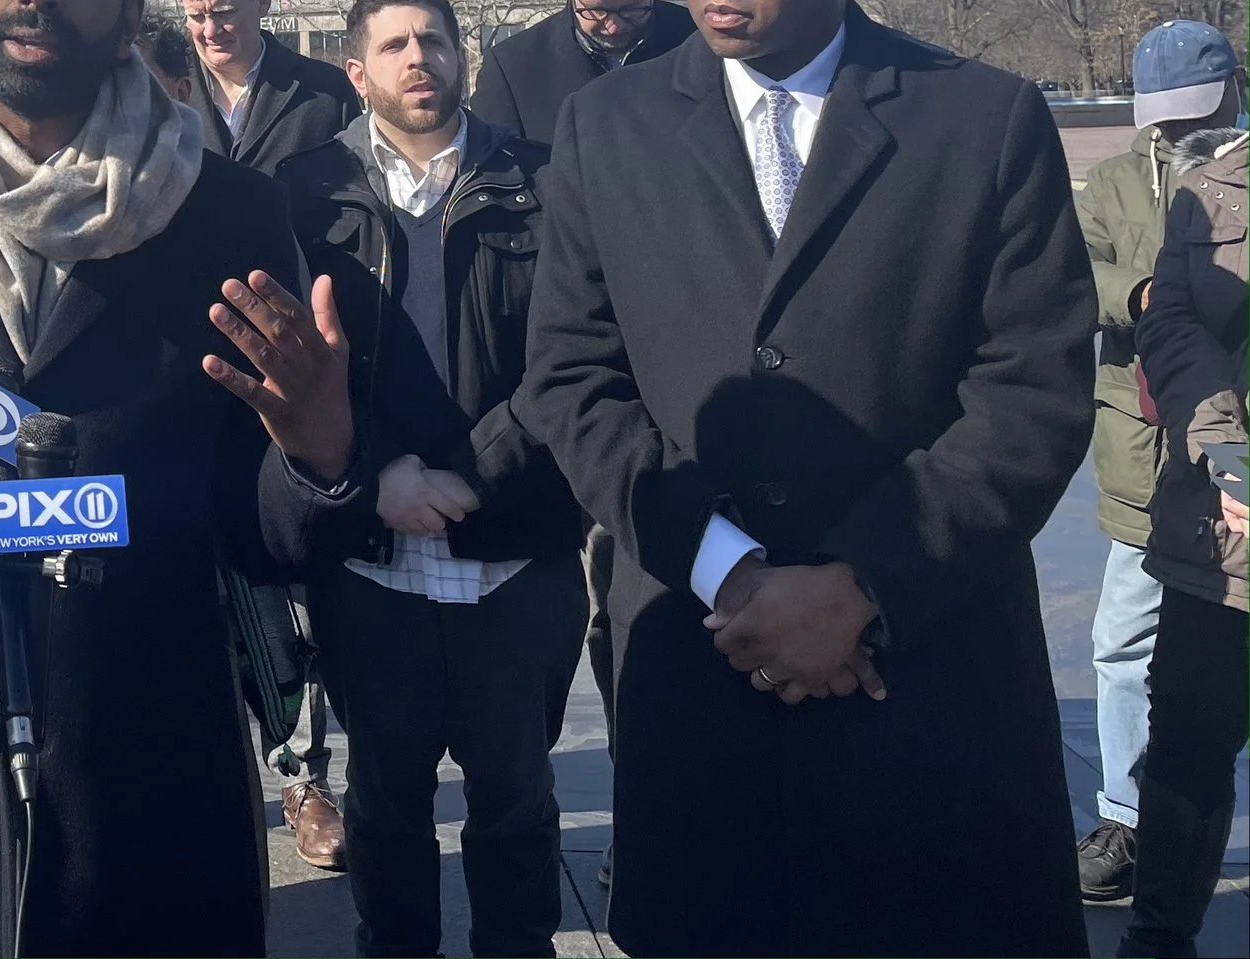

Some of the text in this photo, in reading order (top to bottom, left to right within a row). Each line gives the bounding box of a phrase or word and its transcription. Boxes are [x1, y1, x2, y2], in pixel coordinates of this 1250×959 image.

[260, 17, 296, 29] EUM
[12, 535, 56, 548] YORK'S
[56, 533, 88, 545] VERY
[88, 531, 118, 544] OWN
